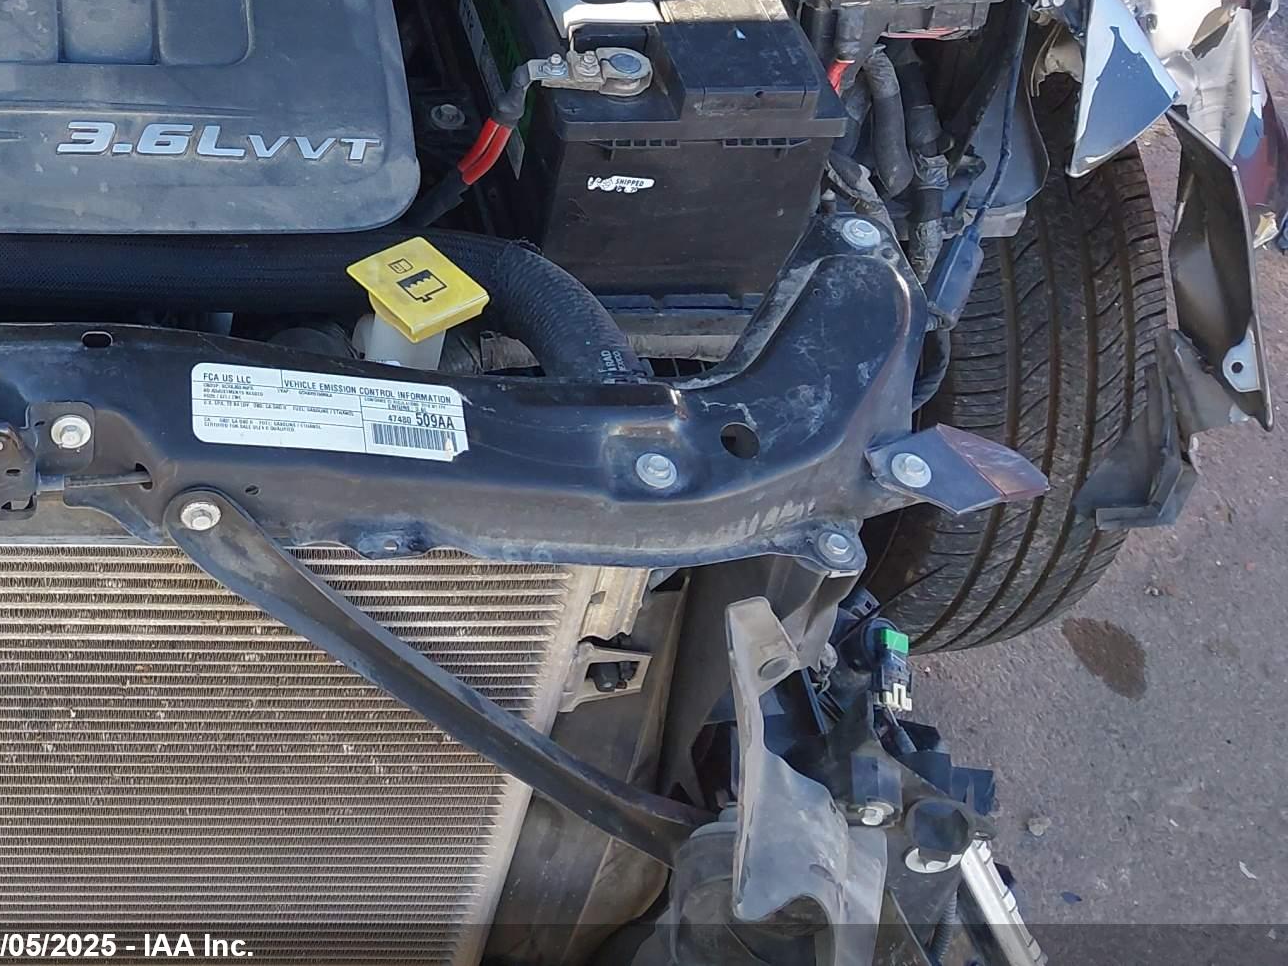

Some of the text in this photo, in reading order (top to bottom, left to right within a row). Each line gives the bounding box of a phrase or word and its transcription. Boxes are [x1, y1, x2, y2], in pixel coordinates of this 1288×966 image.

[203, 372, 252, 384] FCA US LLC
[284, 379, 316, 390] VEHICLE
[319, 383, 357, 394] EMISSION
[359, 387, 395, 398] CONTROL
[397, 391, 451, 404] INFORMATION
[415, 413, 455, 430] 509AA
